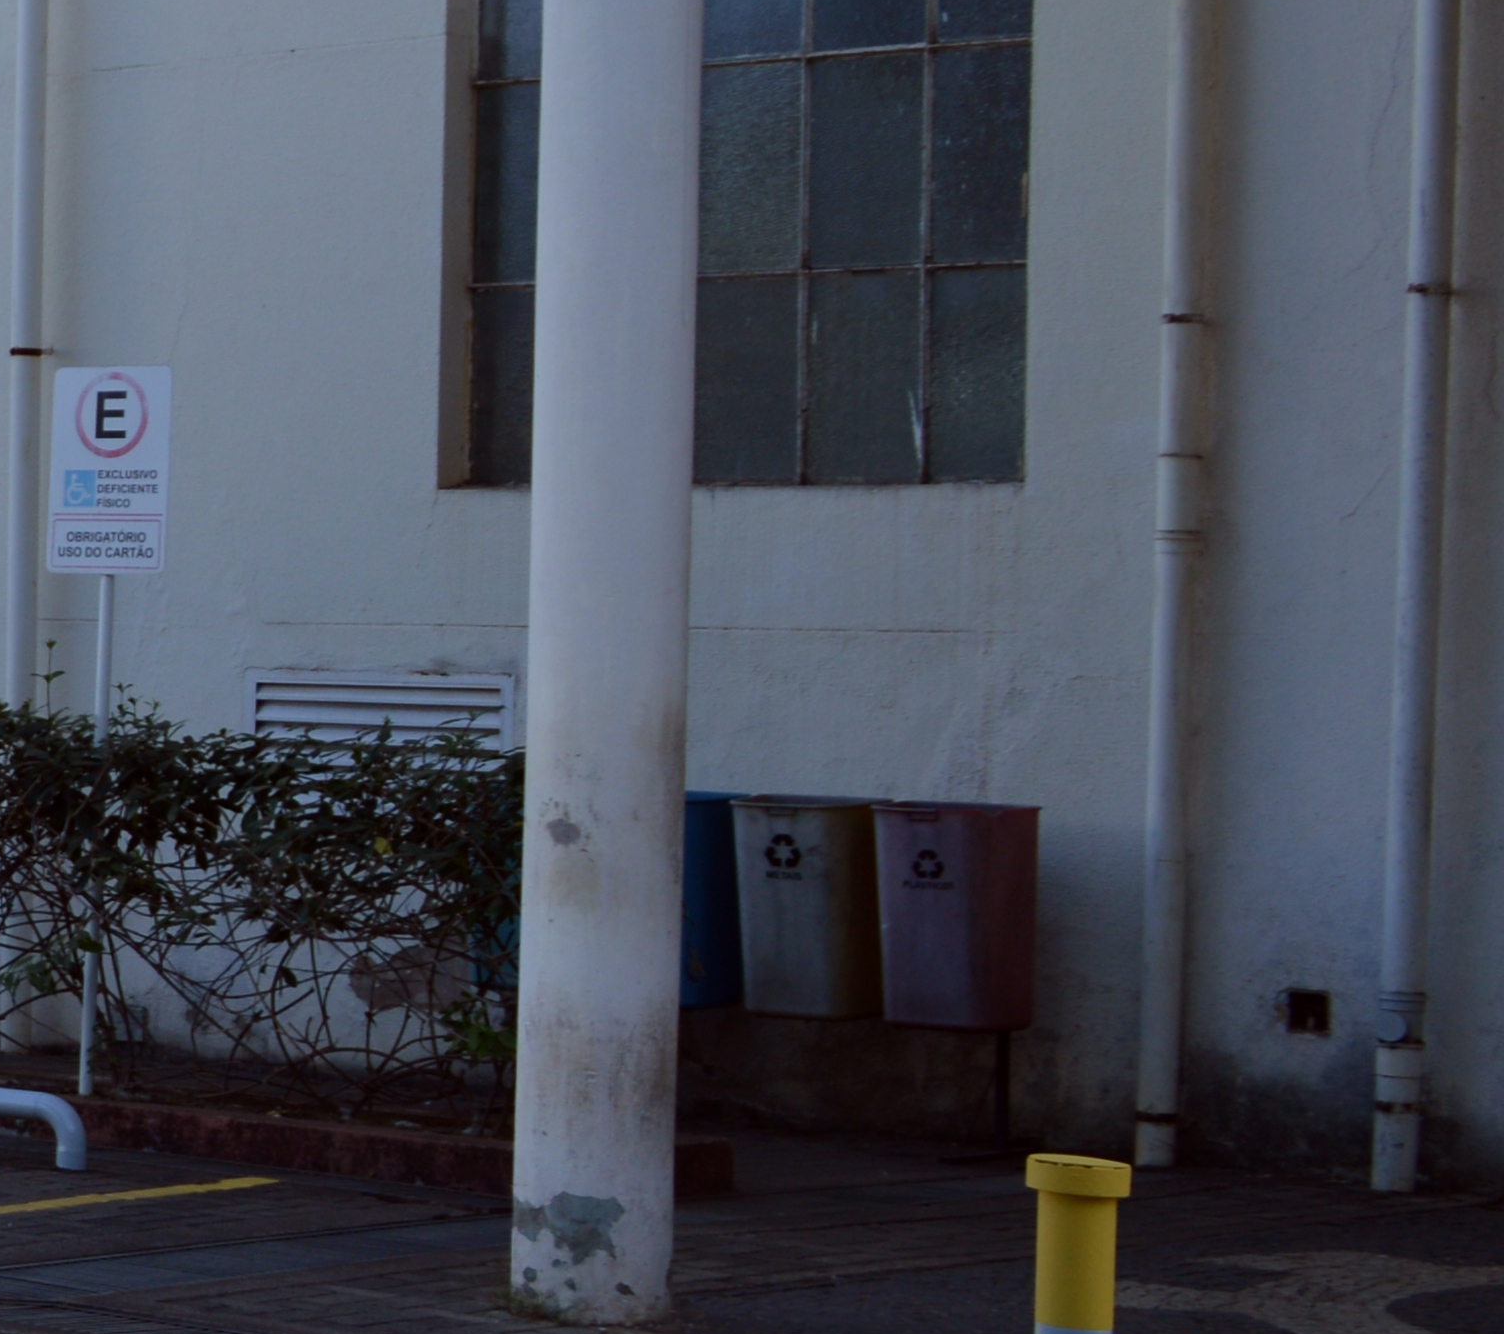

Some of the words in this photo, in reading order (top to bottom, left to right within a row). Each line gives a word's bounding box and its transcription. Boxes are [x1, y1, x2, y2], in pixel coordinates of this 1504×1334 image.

[95, 390, 127, 439] E
[97, 470, 158, 480] EXCLUSIVO
[96, 484, 159, 494] DEFICIENTE
[96, 497, 131, 508] FÍSICO
[66, 528, 147, 543] OBRIGATÓRIO
[58, 546, 82, 557] USO
[84, 547, 102, 558] DO
[105, 544, 154, 558] CARTÃO
